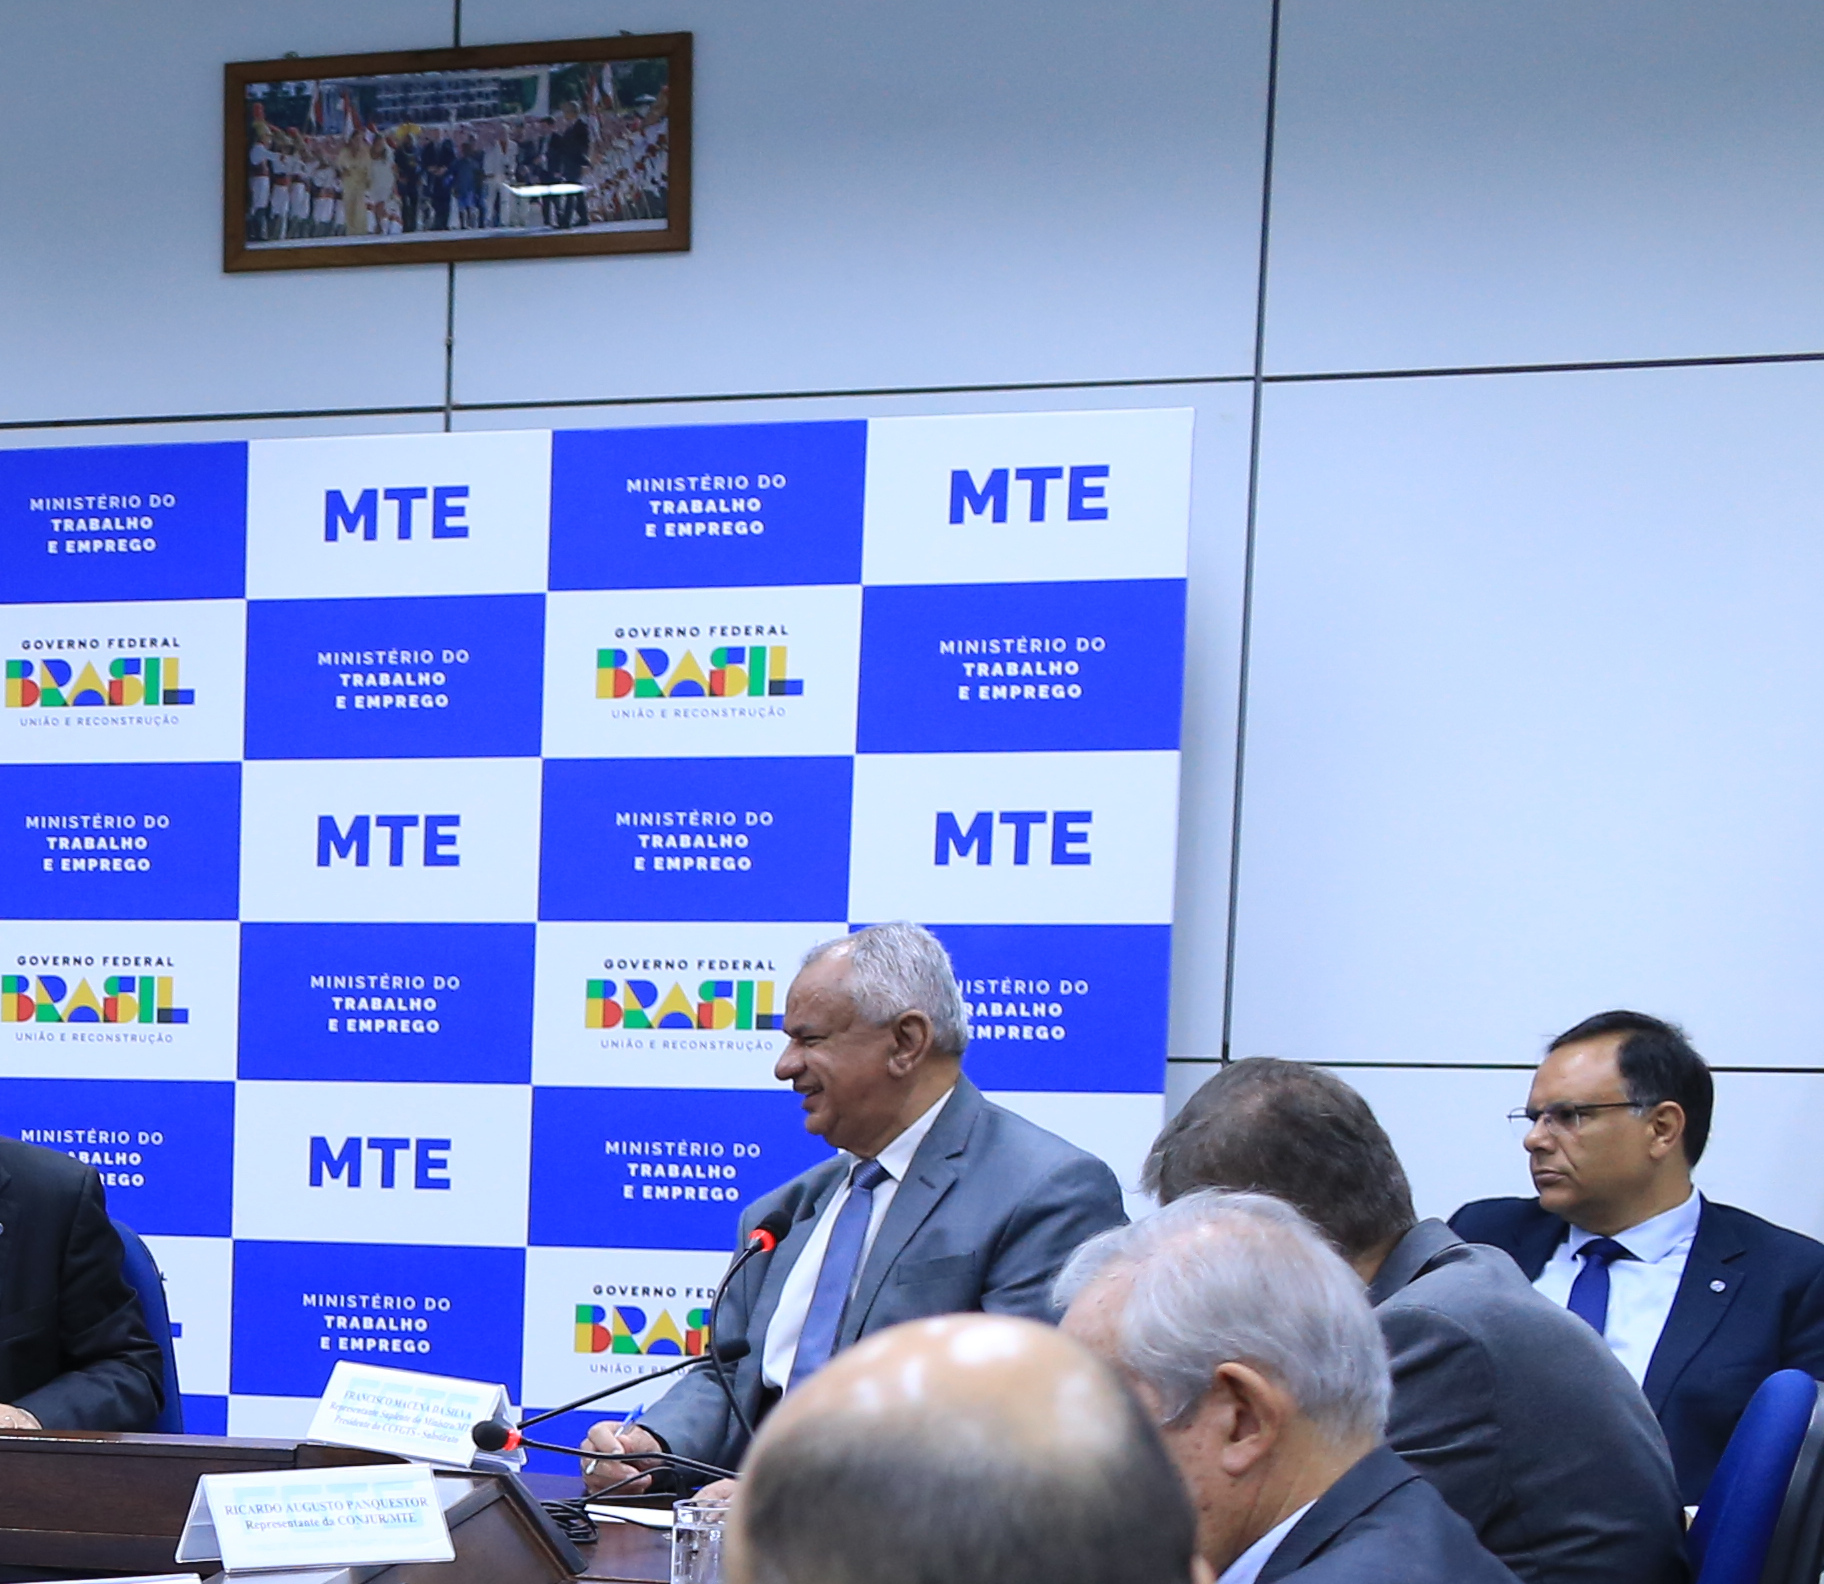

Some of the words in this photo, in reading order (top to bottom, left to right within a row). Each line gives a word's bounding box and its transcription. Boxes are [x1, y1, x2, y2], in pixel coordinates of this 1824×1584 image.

[627, 473, 748, 492] MINISTÉRIO
[758, 474, 786, 488] DO
[31, 493, 141, 510] MINISTÉRIO
[150, 494, 175, 507] DO
[949, 465, 1110, 524] MTE
[325, 485, 469, 542] MTE
[649, 498, 761, 514] TRABALHO
[51, 517, 153, 531] TRABALHO
[646, 524, 656, 537] E
[665, 521, 764, 537] EMPREGO
[48, 541, 58, 553] E
[66, 538, 156, 553] EMPREGO
[615, 626, 700, 638] GOVERNO
[709, 625, 788, 636] FEDERAL
[21, 639, 100, 650] GOVERNO
[108, 637, 180, 649] FEDERAL
[940, 635, 1066, 654] MINISTÉRIO
[1077, 637, 1105, 652] DO
[318, 648, 433, 665] MINISTÉRIO
[443, 649, 469, 663] DO
[596, 645, 804, 699] BRASIL
[963, 661, 1079, 677] TRABALHO
[5, 656, 196, 708] BRASIL
[340, 672, 445, 687] TRABALHO
[959, 686, 970, 700] E
[979, 684, 1082, 700] EMPREGO
[336, 696, 346, 709] E
[355, 694, 448, 708] EMPREGO
[21, 715, 59, 726] UNIÃO
[65, 717, 70, 725] E
[78, 713, 178, 726] RECONSTRUÇÃO
[26, 813, 136, 828] MINISTÉRIO
[144, 815, 169, 828] DO
[616, 809, 736, 826] MINISTÉRIO
[746, 812, 773, 826] DO
[47, 837, 147, 850] TRABALHO
[317, 815, 460, 867] MTE
[638, 834, 748, 848] TRABALHO
[935, 811, 1092, 865] MTE
[44, 858, 53, 871] E
[61, 858, 150, 871] EMPREGO
[635, 857, 645, 870] E
[654, 857, 751, 870] EMPREGO
[17, 956, 94, 966] GOVERNO
[103, 956, 174, 967] FEDERAL
[604, 959, 688, 970] GOVERNO
[698, 960, 775, 971] FEDERAL
[311, 973, 424, 989] MINISTÉRIO
[434, 976, 459, 989] DO
[1, 974, 189, 1024] BRASIL
[332, 997, 436, 1011] TRABALHO
[586, 978, 782, 1031] BRASIL
[329, 1019, 338, 1031] E
[347, 1019, 439, 1032] EMPREGO
[16, 1030, 54, 1041] UNIÃO
[61, 1033, 65, 1041] E
[73, 1031, 172, 1043] RECONSTRUÇÃO
[22, 1128, 129, 1144] MINISTÉRIO
[138, 1132, 163, 1145] DO
[606, 1139, 724, 1157] MINISTÉRIO
[734, 1144, 760, 1157] DO
[309, 1136, 451, 1190] MTE
[627, 1163, 736, 1179] TRABALHO
[624, 1185, 634, 1198] E
[643, 1185, 740, 1201] EMPREGO
[303, 1292, 415, 1310] MINISTÉRIO
[425, 1298, 450, 1311] DO
[324, 1315, 427, 1331] TRABALHO
[321, 1337, 330, 1349] E
[339, 1337, 430, 1353] EMPREGO
[224, 1502, 282, 1515] RICARDO
[285, 1500, 344, 1513] AUGUSTO
